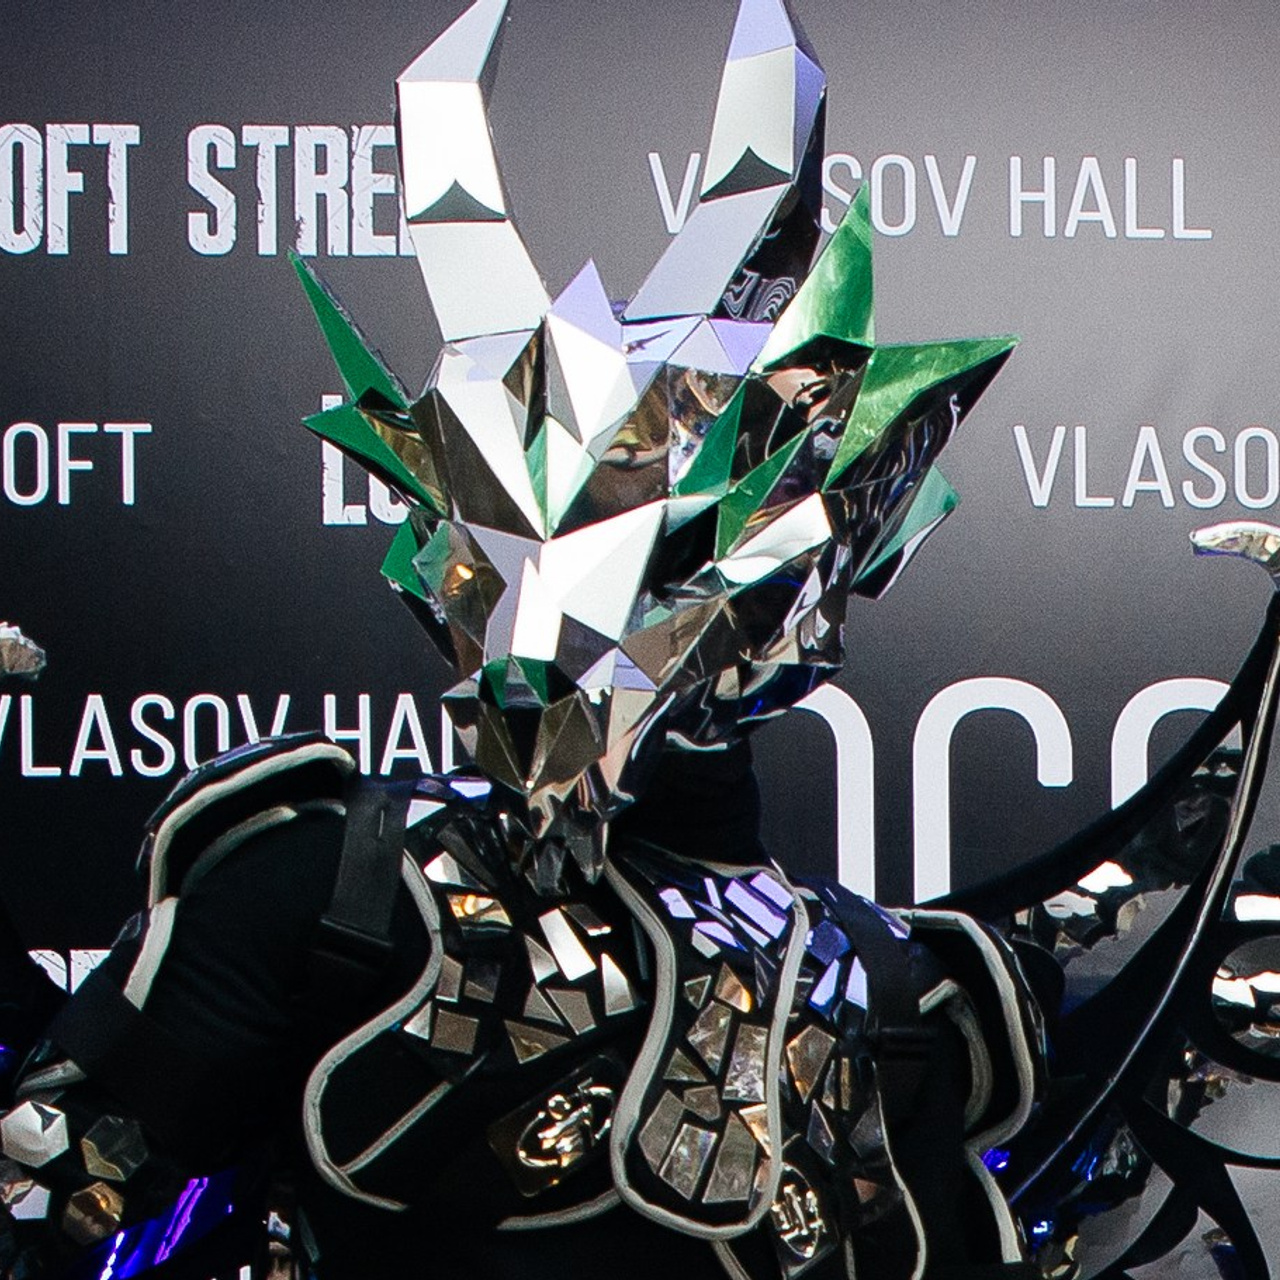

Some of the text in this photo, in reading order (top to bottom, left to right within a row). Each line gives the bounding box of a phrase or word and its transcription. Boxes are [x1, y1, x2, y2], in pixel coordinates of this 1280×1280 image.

[0, 117, 416, 256] OFT STRE
[648, 144, 1213, 239] VSOV HALL
[3, 422, 153, 506] OFT
[0, 694, 291, 777] LASOV
